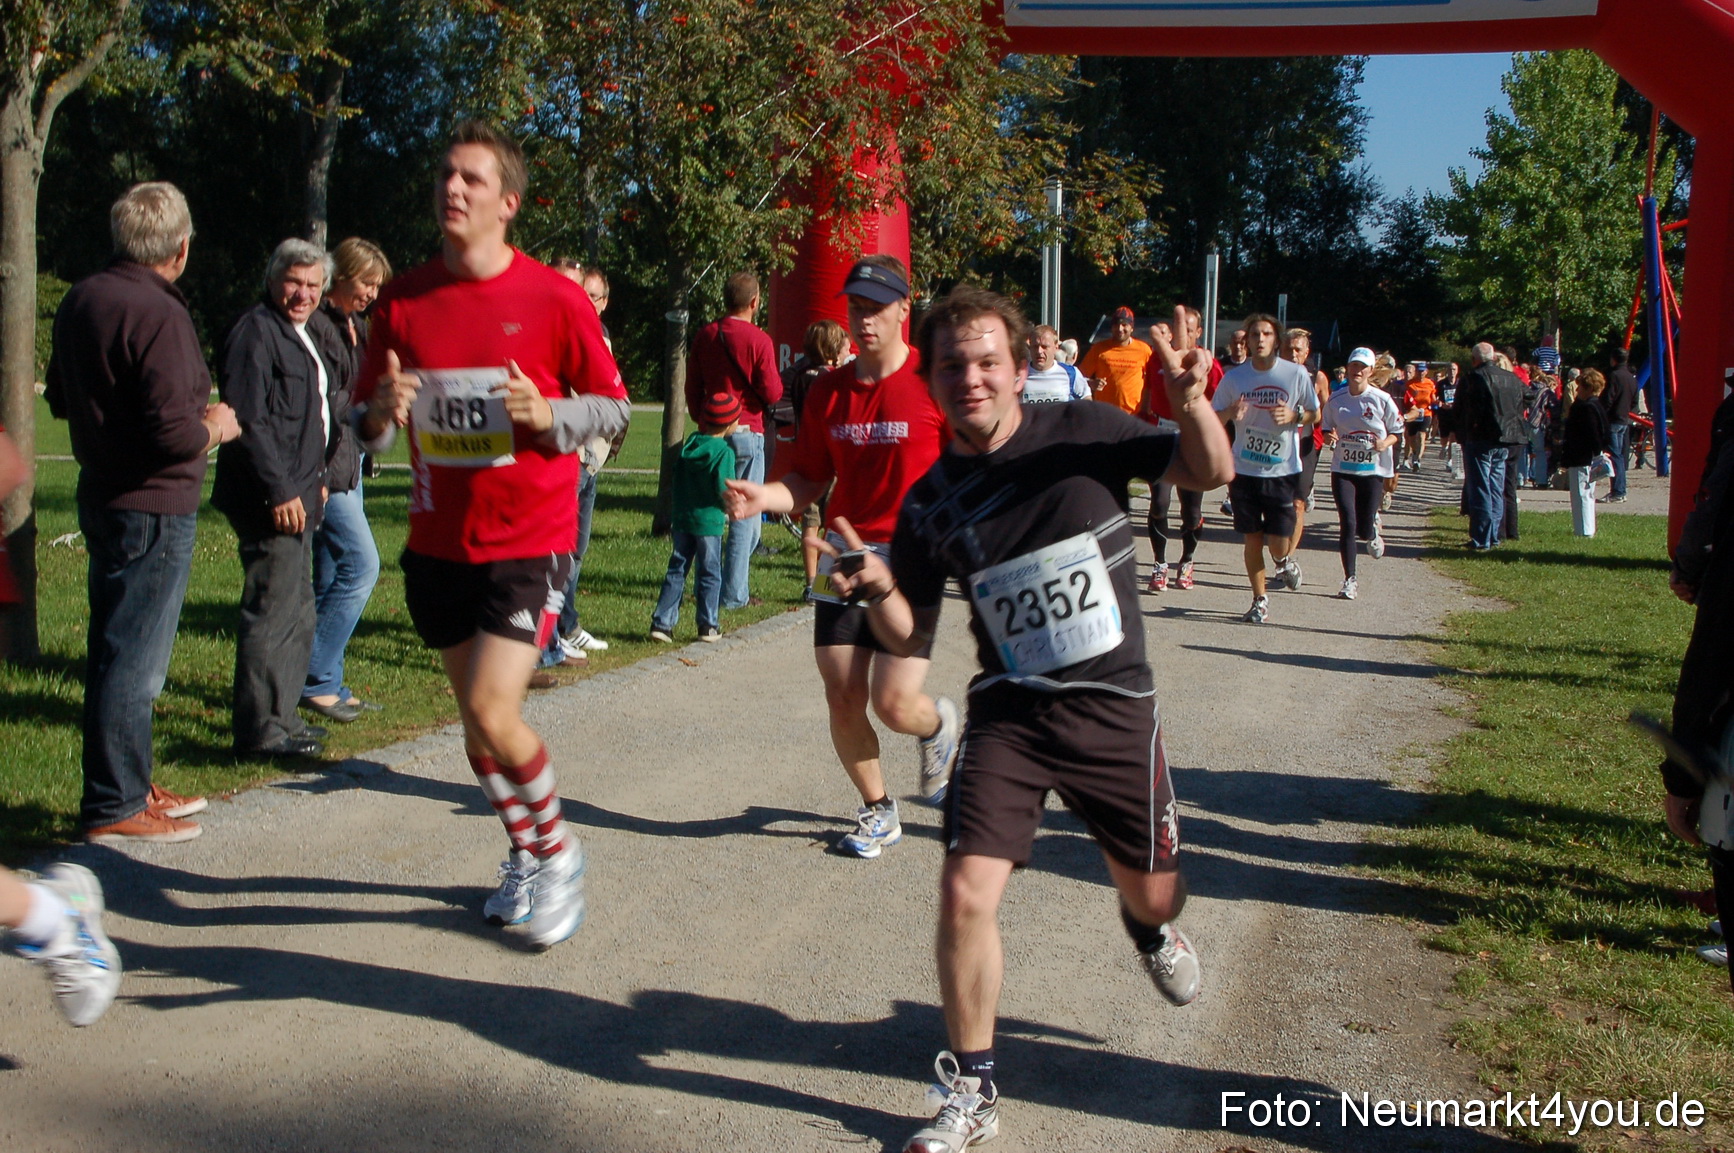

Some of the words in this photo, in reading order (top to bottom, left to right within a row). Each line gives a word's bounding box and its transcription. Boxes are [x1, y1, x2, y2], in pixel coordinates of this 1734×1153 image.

[429, 396, 487, 431] 468
[430, 433, 492, 453] Markus
[1246, 436, 1281, 456] 3372
[1249, 451, 1272, 464] Patrik
[1343, 449, 1373, 463] 3494
[995, 571, 1099, 637] 2352
